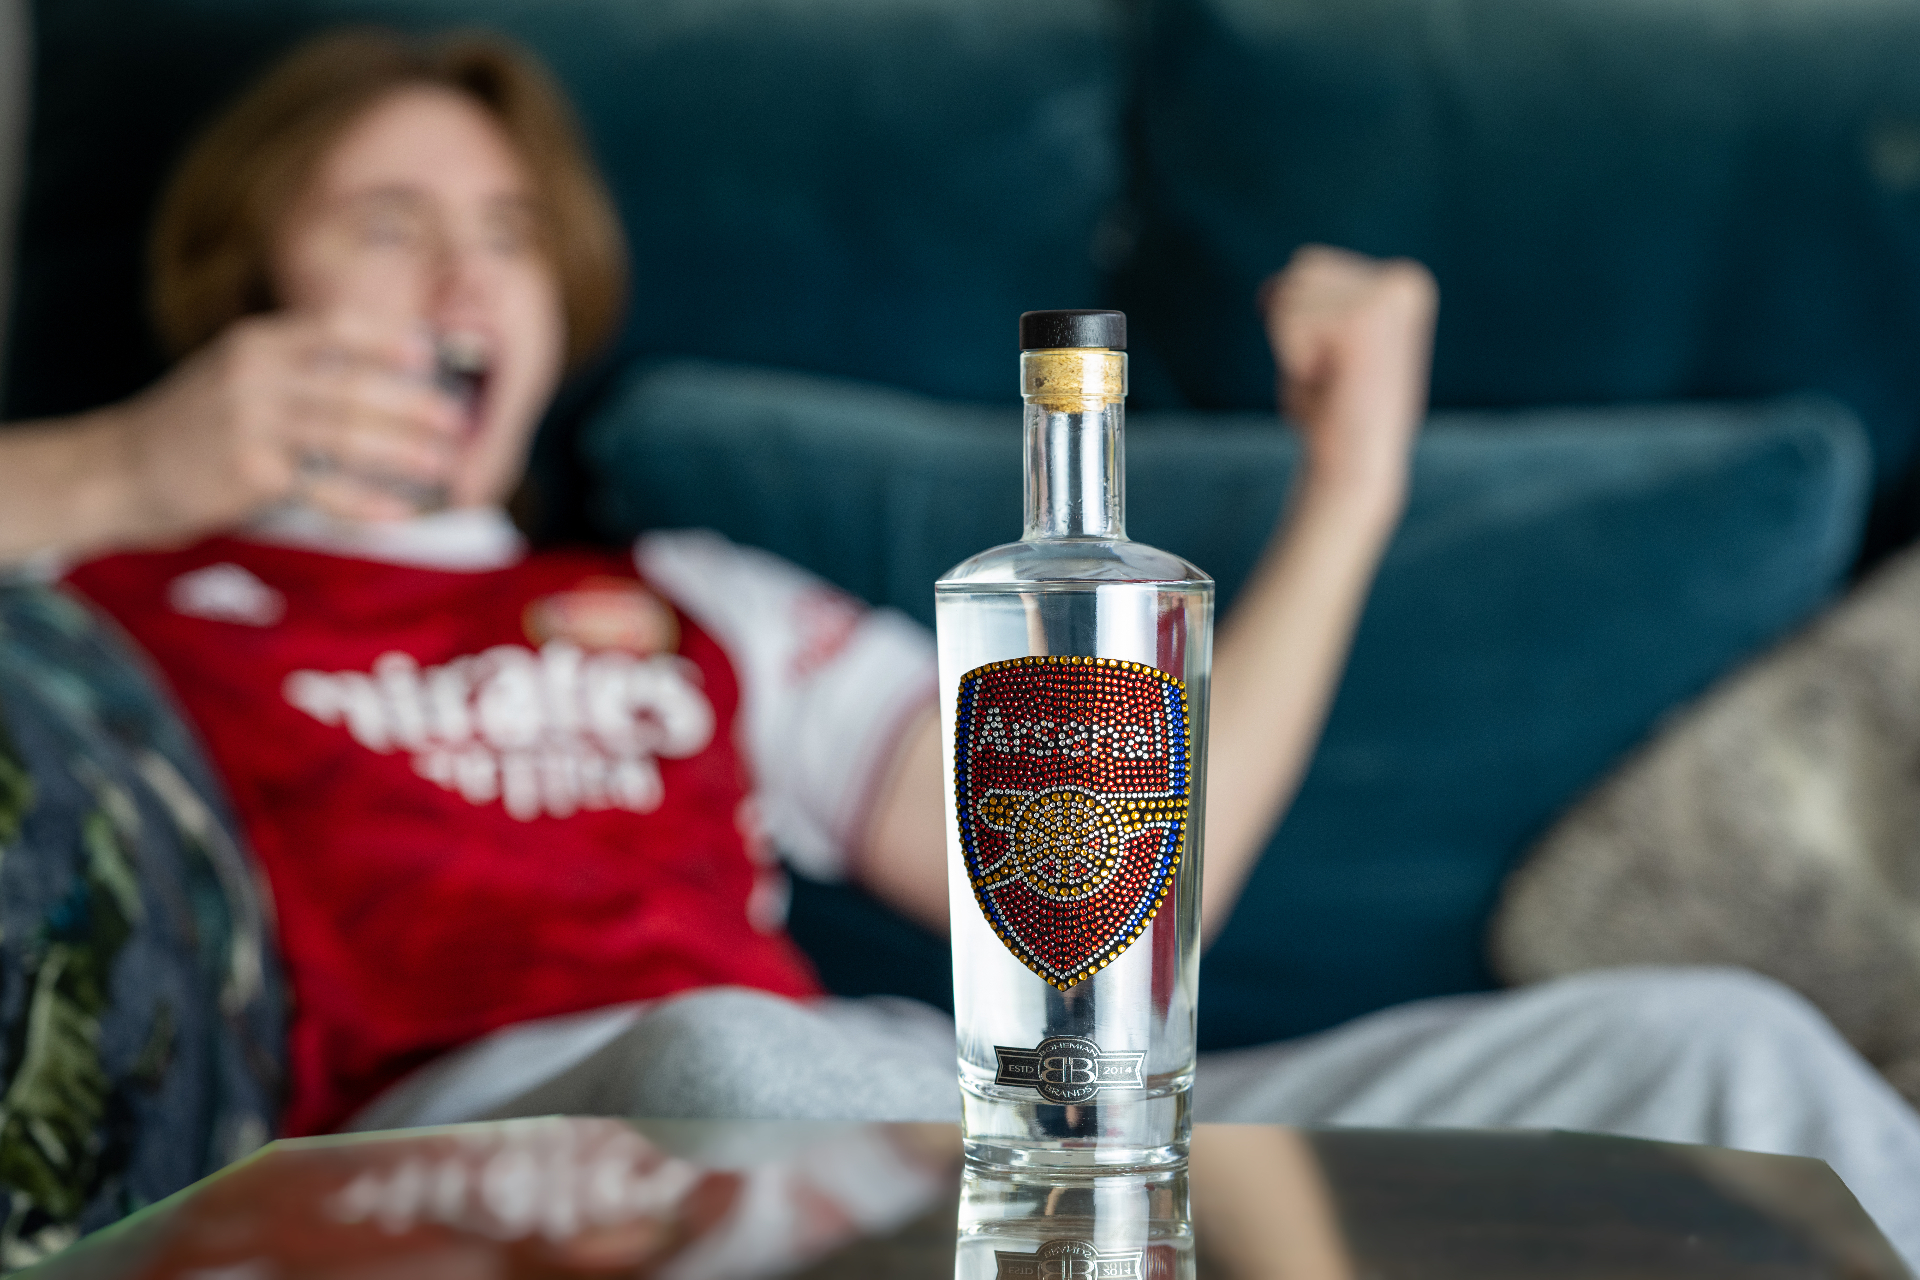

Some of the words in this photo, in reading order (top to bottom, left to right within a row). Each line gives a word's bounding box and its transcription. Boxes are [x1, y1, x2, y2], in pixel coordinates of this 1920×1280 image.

[976, 707, 1162, 759] Arsenal
[1039, 1042, 1098, 1057] BOHEMIAN
[1009, 1064, 1034, 1073] ESTD
[1103, 1066, 1132, 1075] 2014
[1045, 1084, 1093, 1098] BRANDS
